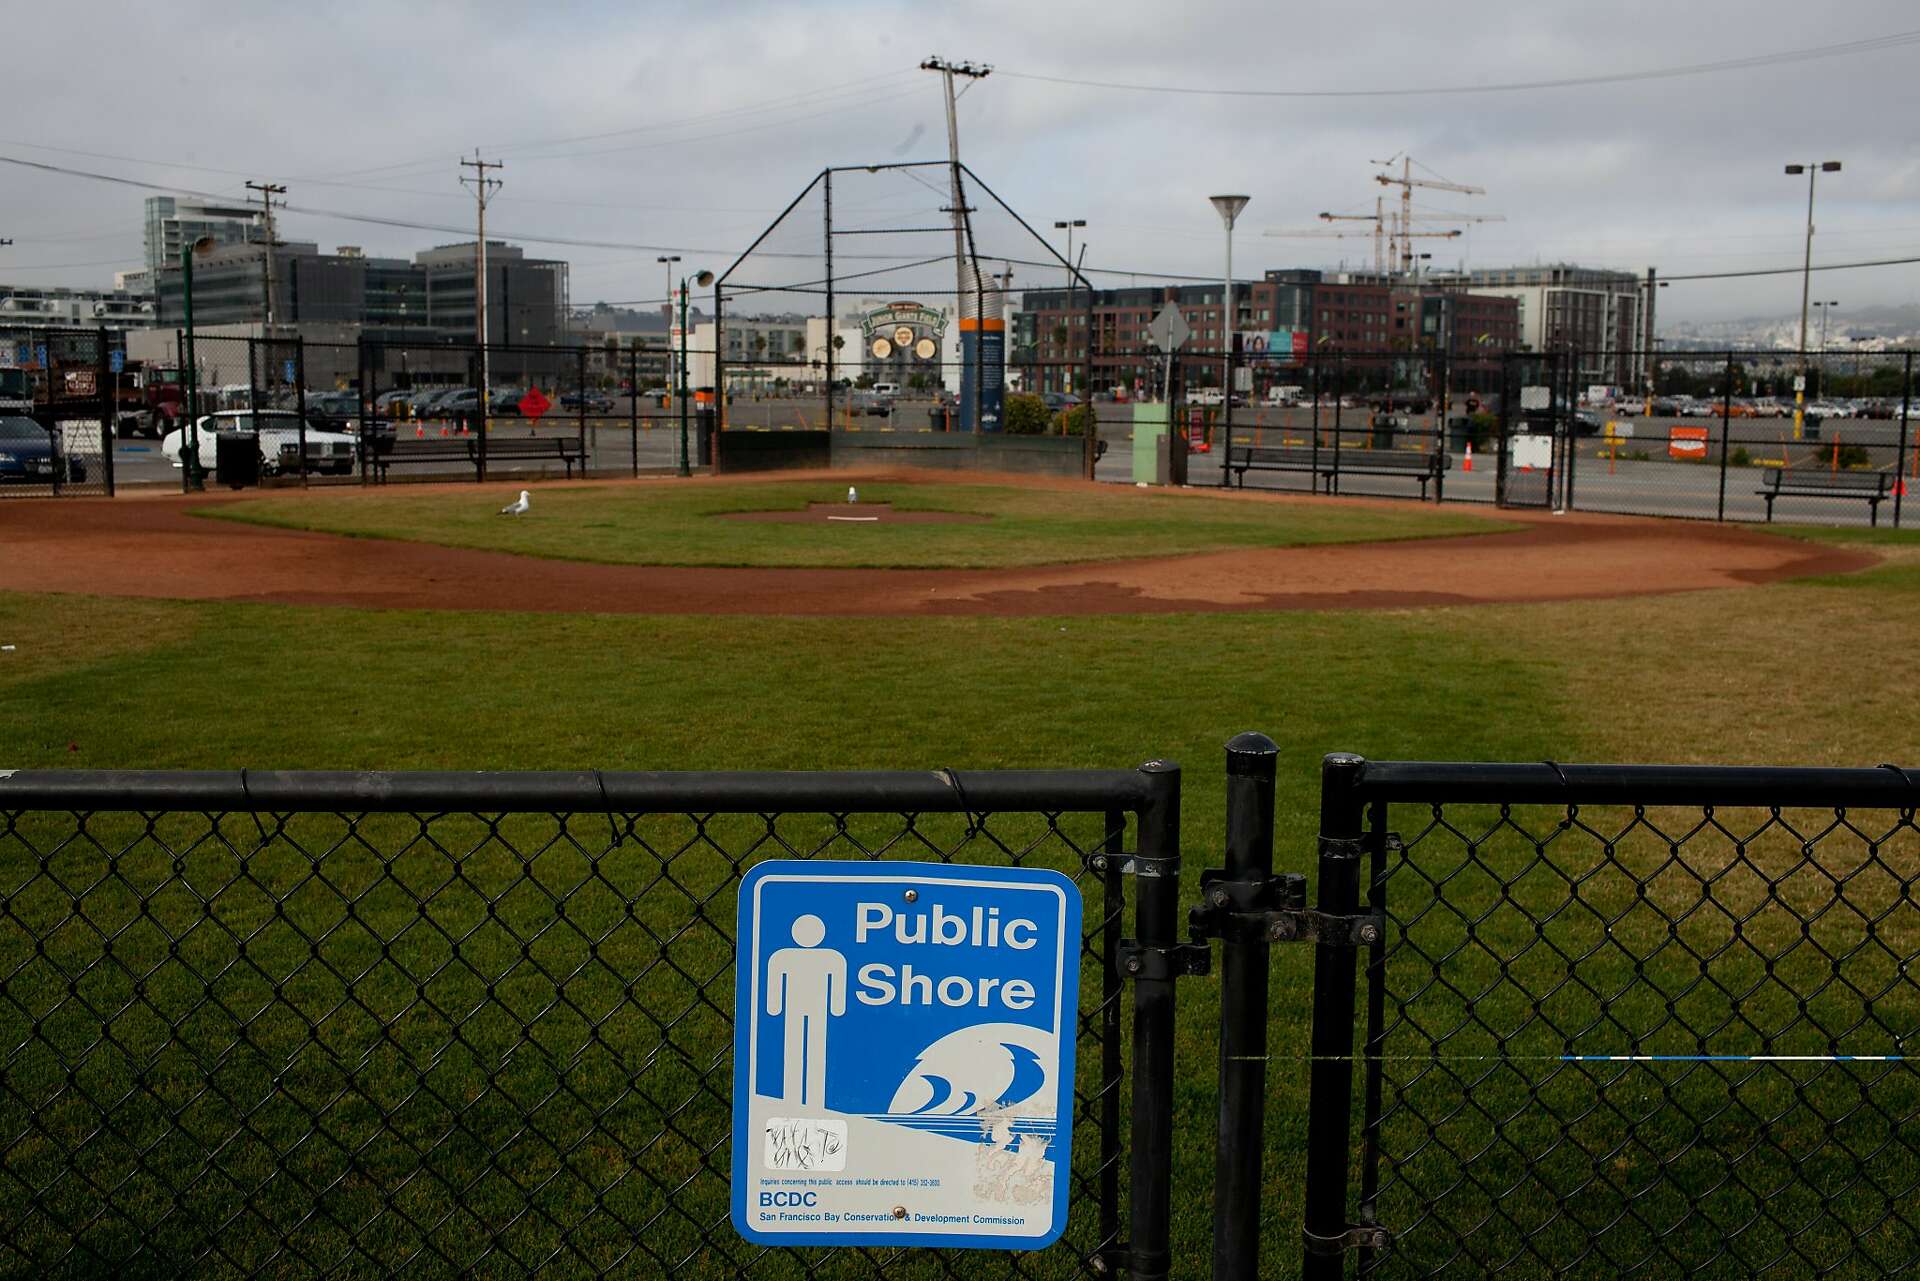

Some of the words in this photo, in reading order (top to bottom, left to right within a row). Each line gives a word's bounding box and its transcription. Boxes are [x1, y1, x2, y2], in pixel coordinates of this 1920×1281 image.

[855, 902, 1038, 950] Public
[855, 963, 1036, 1009] Shore
[781, 1179, 807, 1187] concerning
[808, 1178, 817, 1186] this
[818, 1178, 832, 1187] public
[855, 1178, 871, 1186] should
[880, 1178, 899, 1187] directed
[759, 1191, 817, 1207] BCDC
[760, 1212, 776, 1221] San
[779, 1212, 821, 1221] Francisco
[824, 1212, 840, 1222] Bay
[904, 1213, 911, 1222] &
[914, 1213, 970, 1224] Development
[973, 1214, 1025, 1225] Commission
